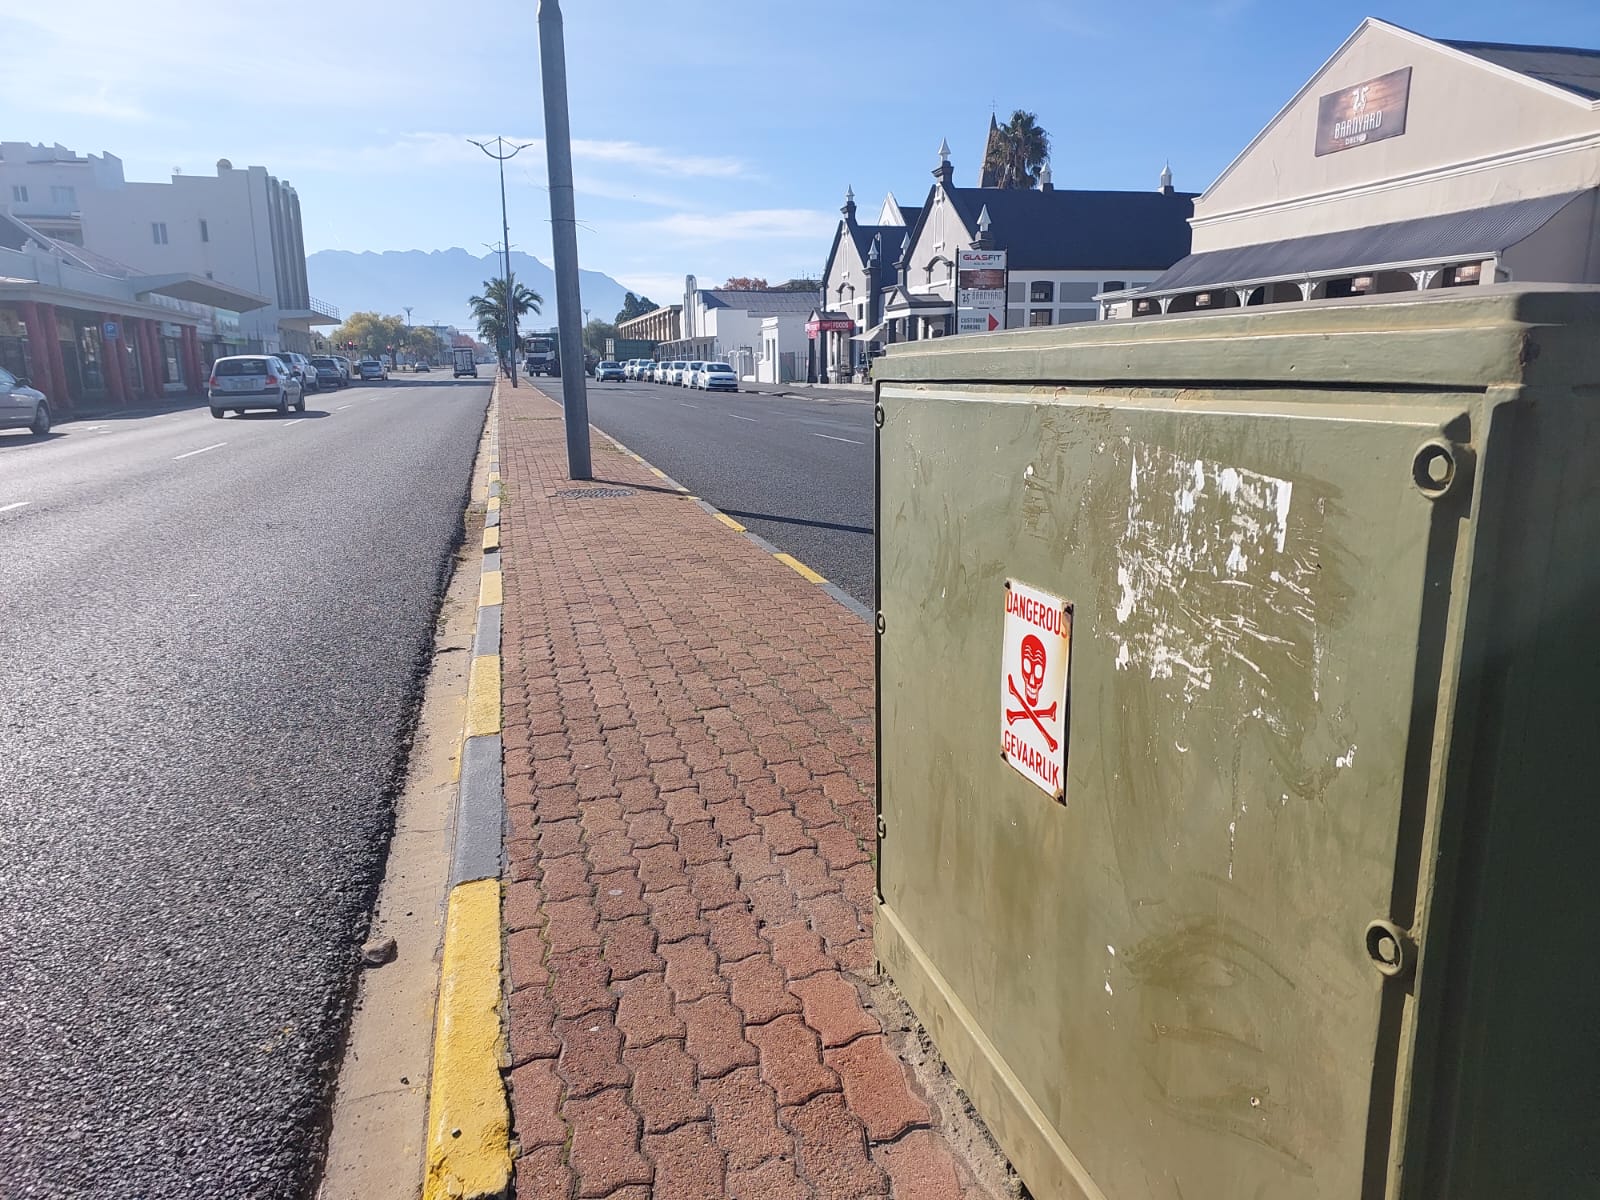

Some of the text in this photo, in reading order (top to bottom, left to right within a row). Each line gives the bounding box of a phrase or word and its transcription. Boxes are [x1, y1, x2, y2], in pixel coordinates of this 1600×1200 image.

[1334, 111, 1382, 139] BARNYARD
[1006, 591, 1068, 638] DANGEROUS
[1004, 730, 1060, 788] GEVAARLIK
